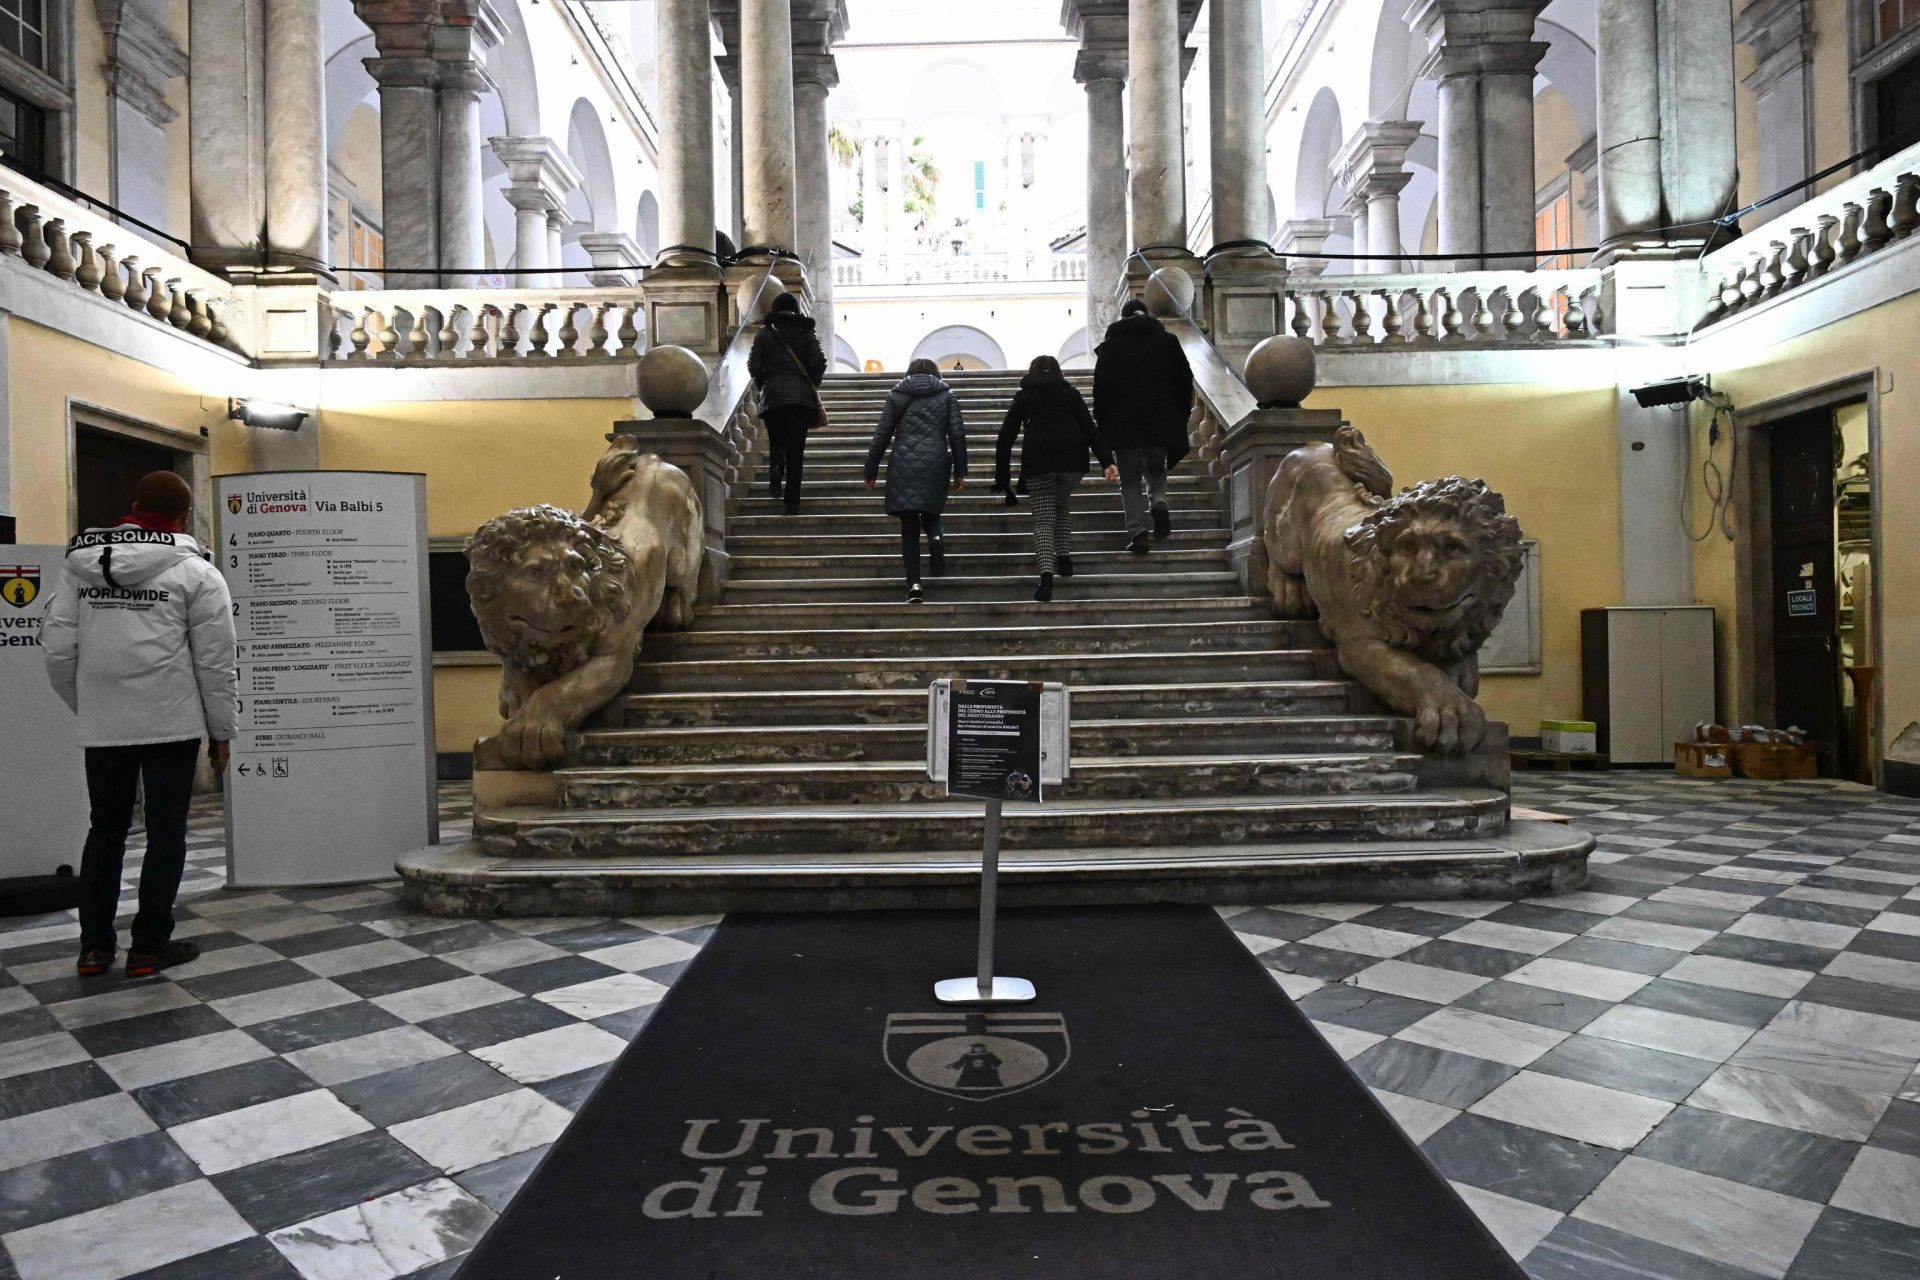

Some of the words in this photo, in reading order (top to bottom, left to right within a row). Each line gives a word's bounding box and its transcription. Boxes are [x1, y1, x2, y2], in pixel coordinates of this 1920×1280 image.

[247, 490, 306, 503] Università
[247, 503, 258, 514] di
[260, 503, 307, 513] Genova
[315, 502, 337, 512] Via
[340, 501, 374, 512] Balbi
[376, 502, 383, 512] 5
[111, 531, 173, 544] SQUAD
[229, 533, 237, 547] 4
[266, 530, 291, 538] QUARTO
[230, 555, 238, 568] 3
[78, 587, 170, 602] WORLDWIDE
[1791, 595, 1813, 603] LOCALE
[232, 602, 240, 616] 2
[679, 1107, 1296, 1160] Università
[641, 1166, 768, 1219] di
[809, 1165, 1332, 1215] Genova
